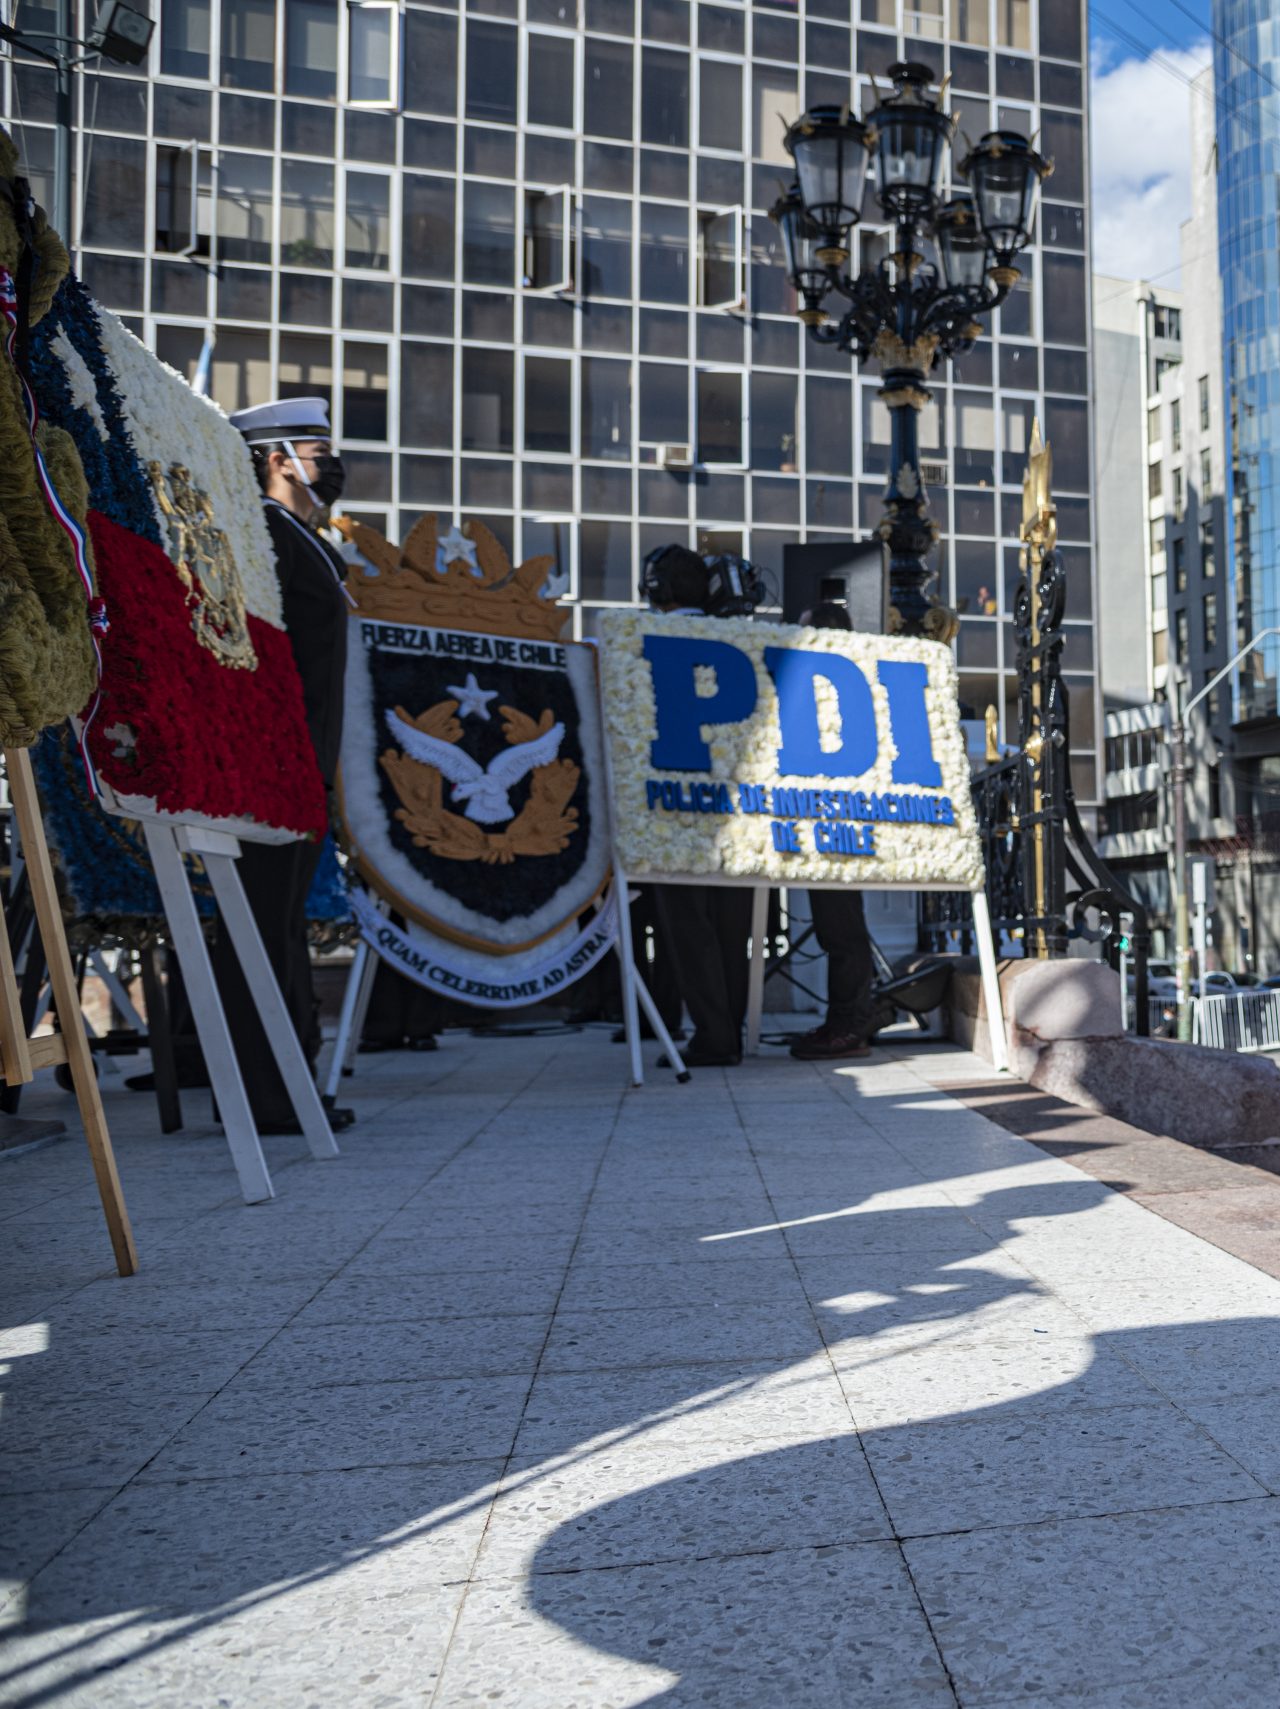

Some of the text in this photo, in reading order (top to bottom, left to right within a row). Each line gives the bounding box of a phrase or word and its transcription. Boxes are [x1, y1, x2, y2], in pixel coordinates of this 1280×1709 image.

[362, 624, 567, 667] FUERZA AEREA DE CHILE
[643, 634, 943, 788] PDI
[645, 780, 954, 825] POLICIA DE INVESTIGACIONES
[770, 821, 876, 855] DE CHILE
[376, 928, 608, 1000] QUAM CELERRIME AD ASTRA
